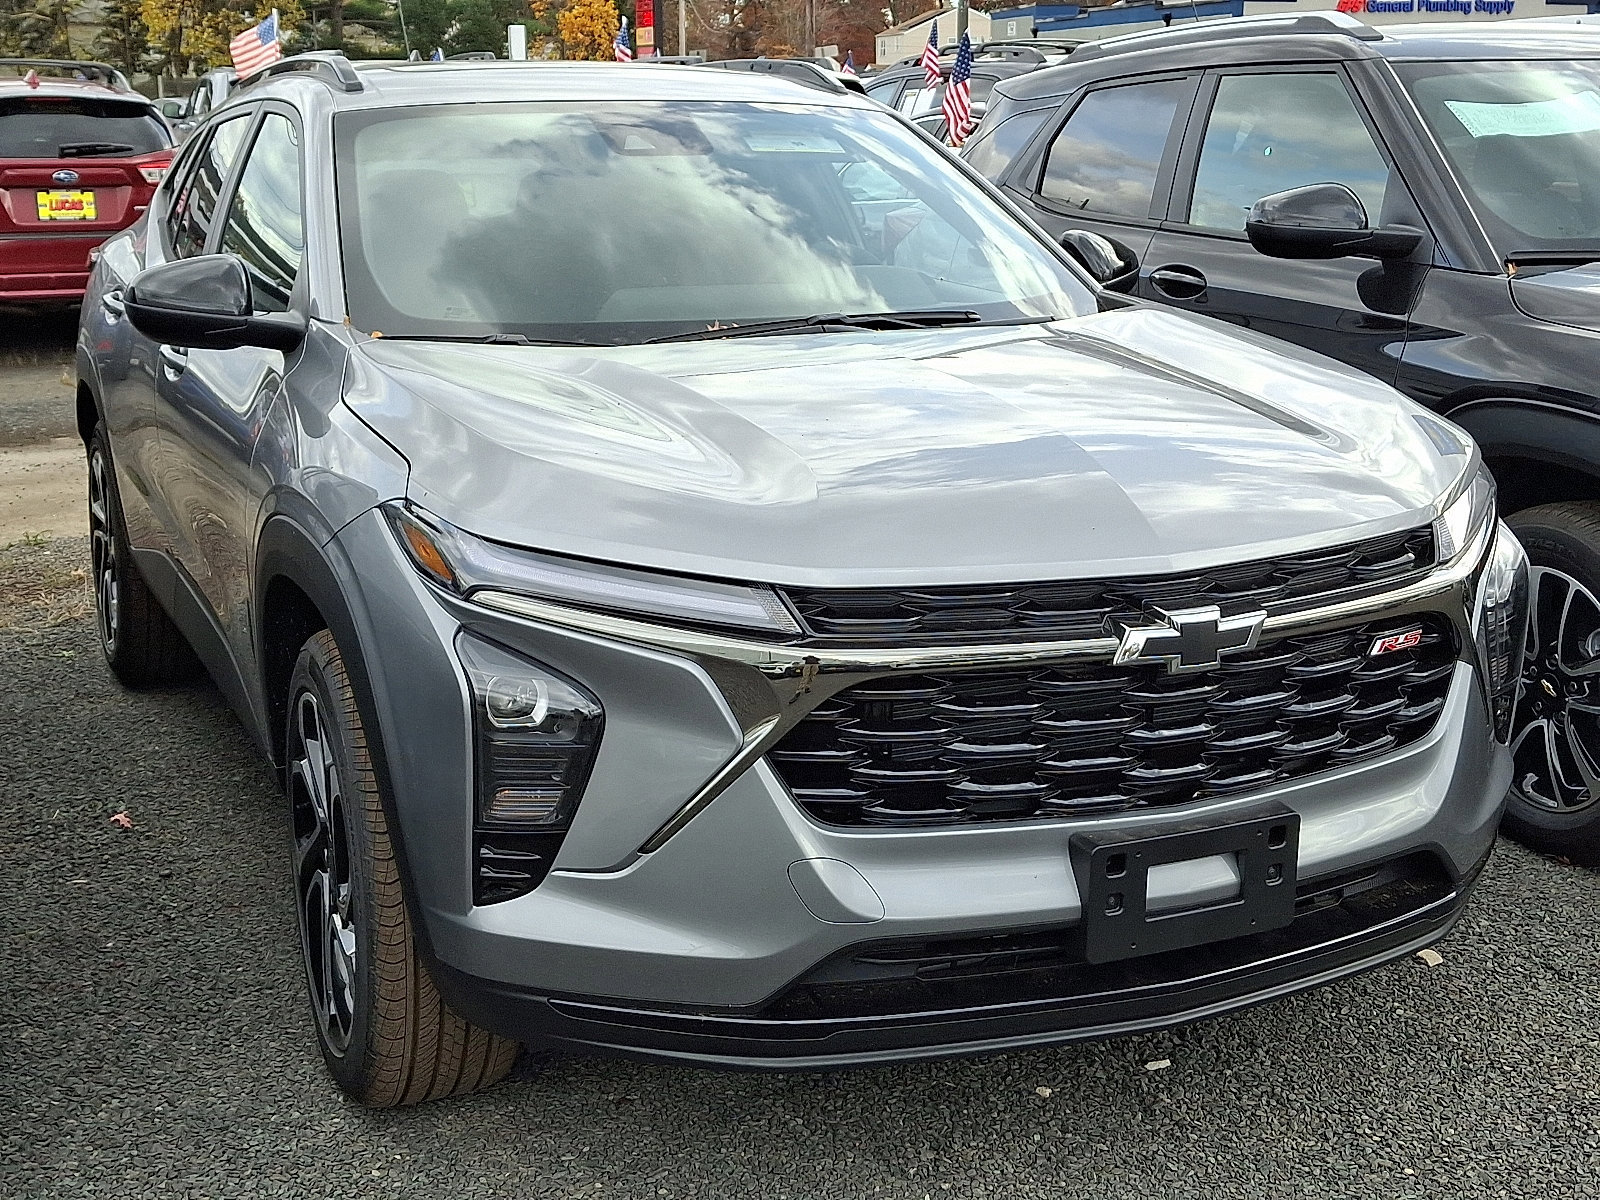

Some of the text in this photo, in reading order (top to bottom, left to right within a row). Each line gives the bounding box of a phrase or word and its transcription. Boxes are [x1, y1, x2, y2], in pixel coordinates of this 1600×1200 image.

[1367, 0, 1413, 12] General
[1417, 0, 1471, 15] Plumbing
[1474, 0, 1515, 15] Supply
[49, 199, 84, 211] LUCAS
[1370, 629, 1422, 655] RS
